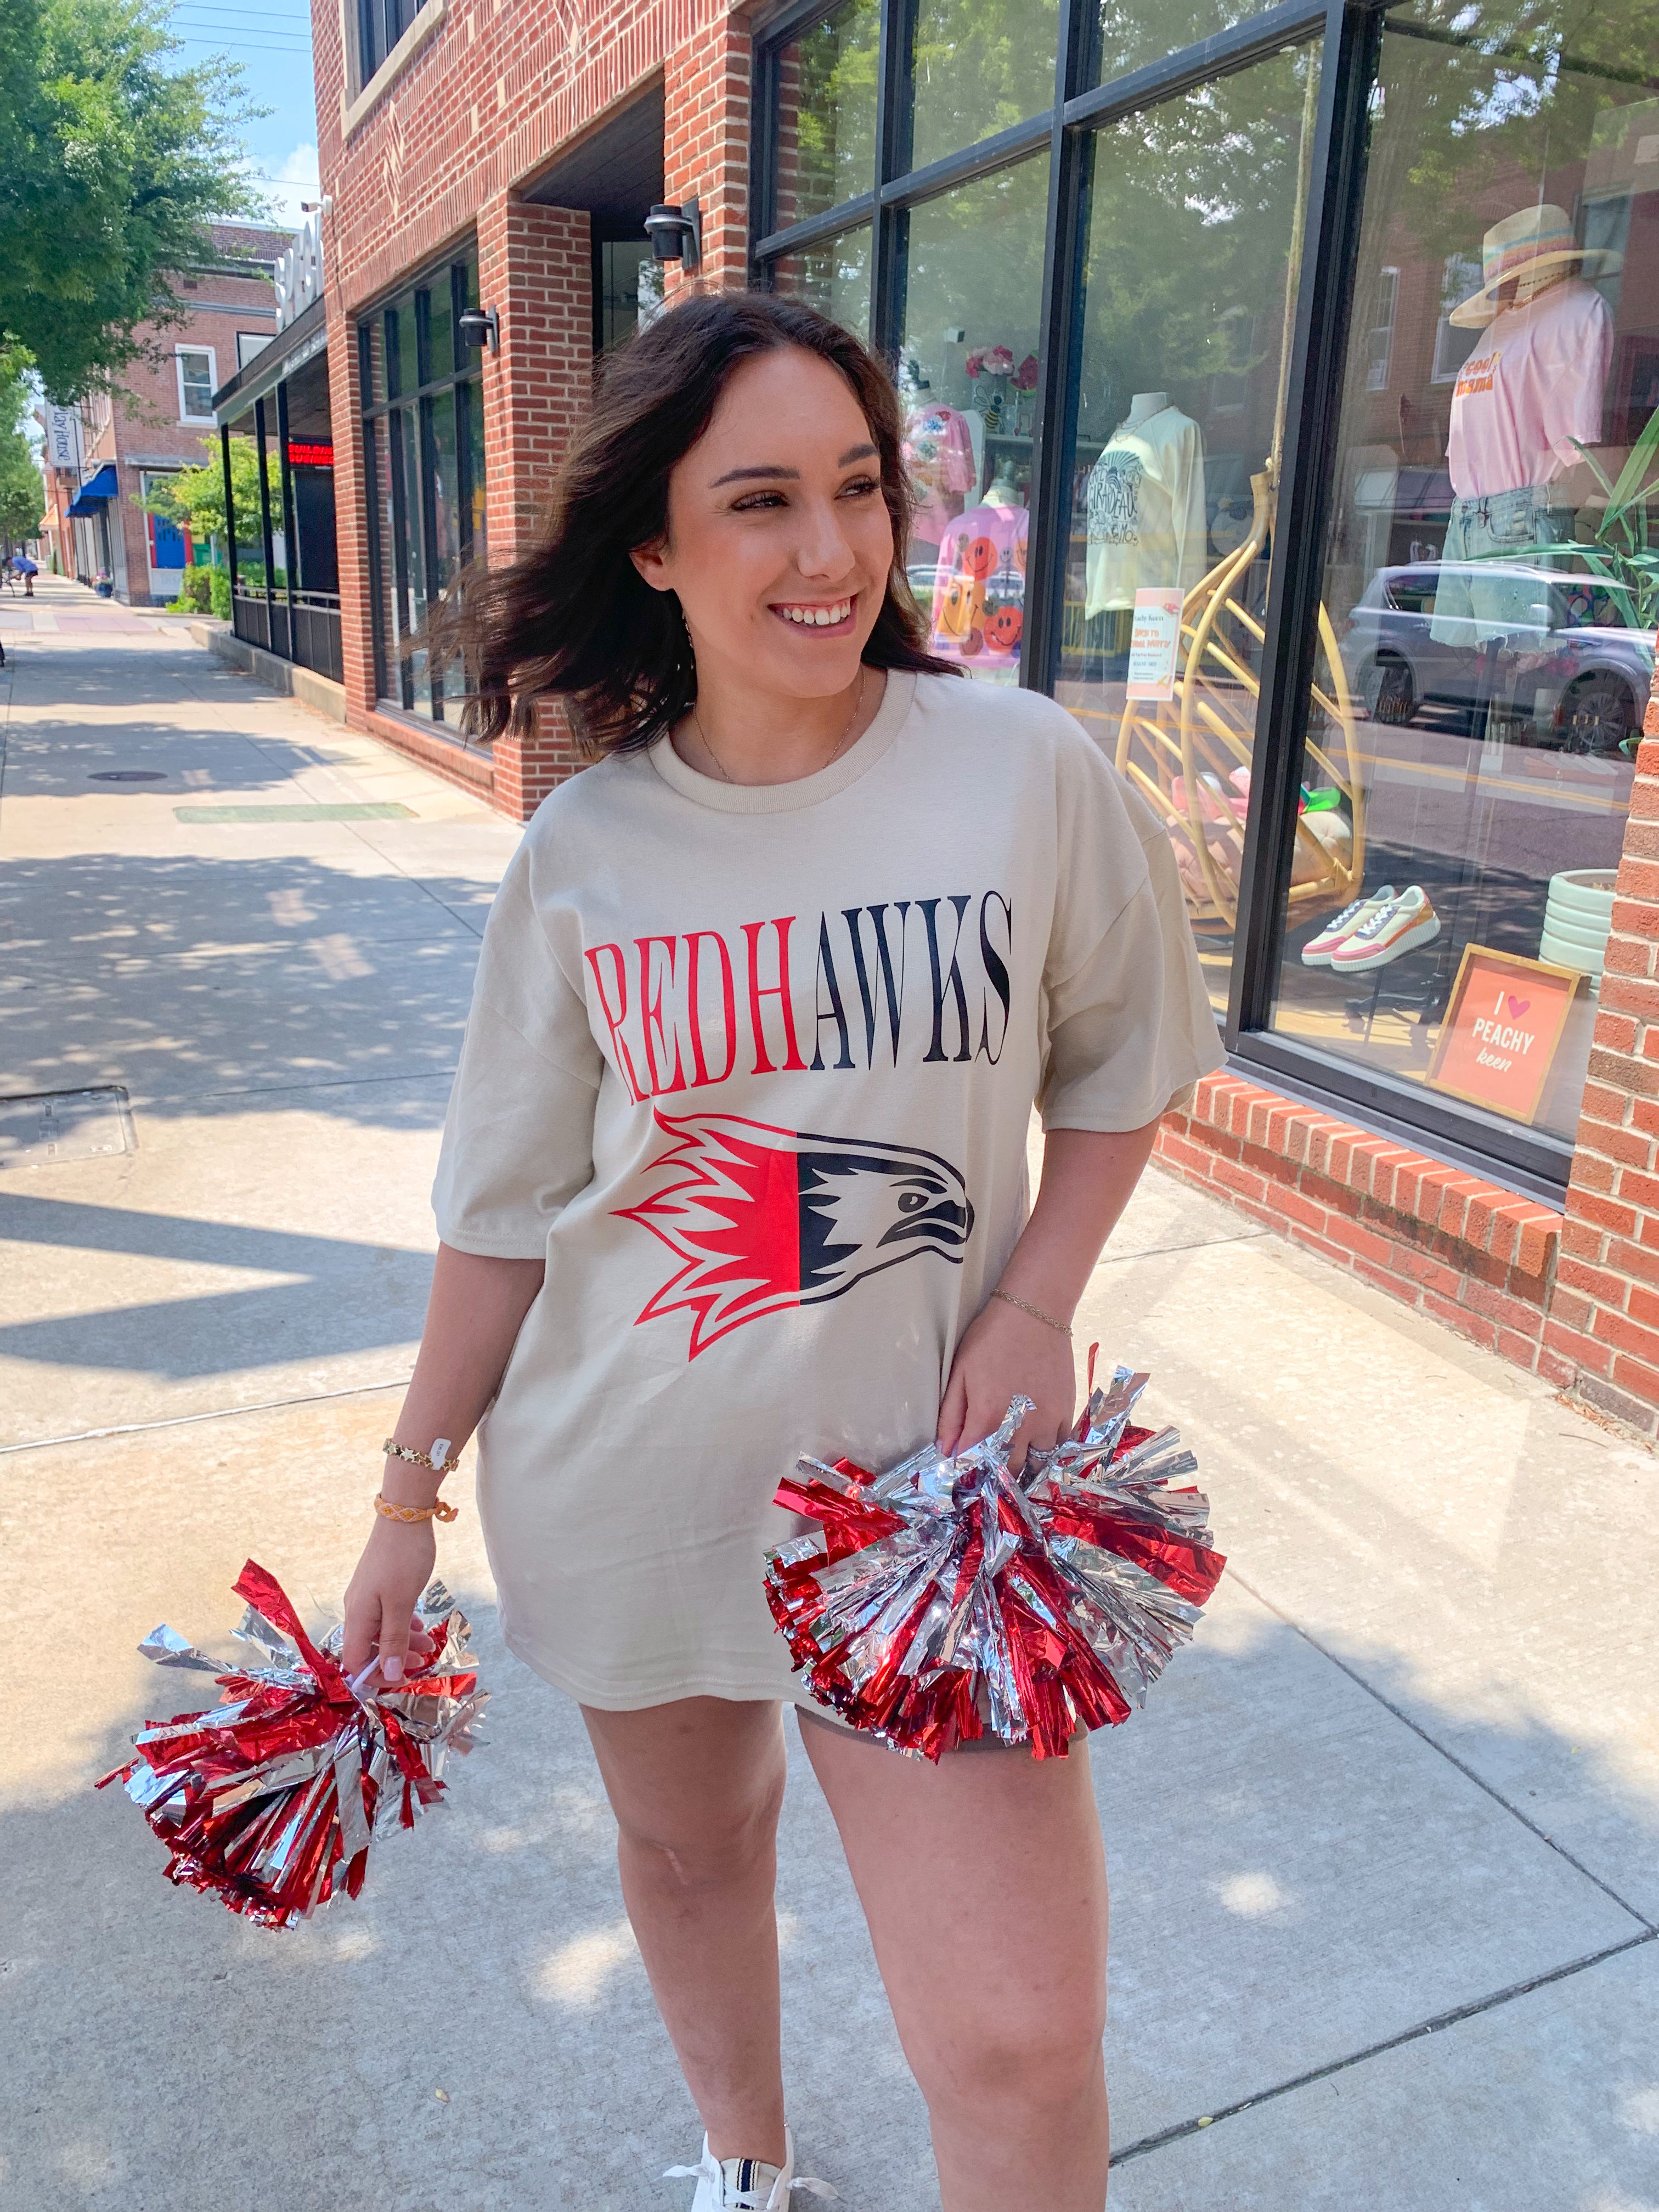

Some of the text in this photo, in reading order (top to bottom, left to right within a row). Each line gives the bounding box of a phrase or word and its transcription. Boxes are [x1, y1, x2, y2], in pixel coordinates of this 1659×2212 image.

[1465, 352, 1496, 376] cool
[1456, 374, 1493, 397] mama
[585, 890, 1012, 1106] REDHAWKS
[1494, 991, 1505, 1015] I
[1472, 1017, 1536, 1055] PEACHY
[1476, 1046, 1513, 1073] keen
